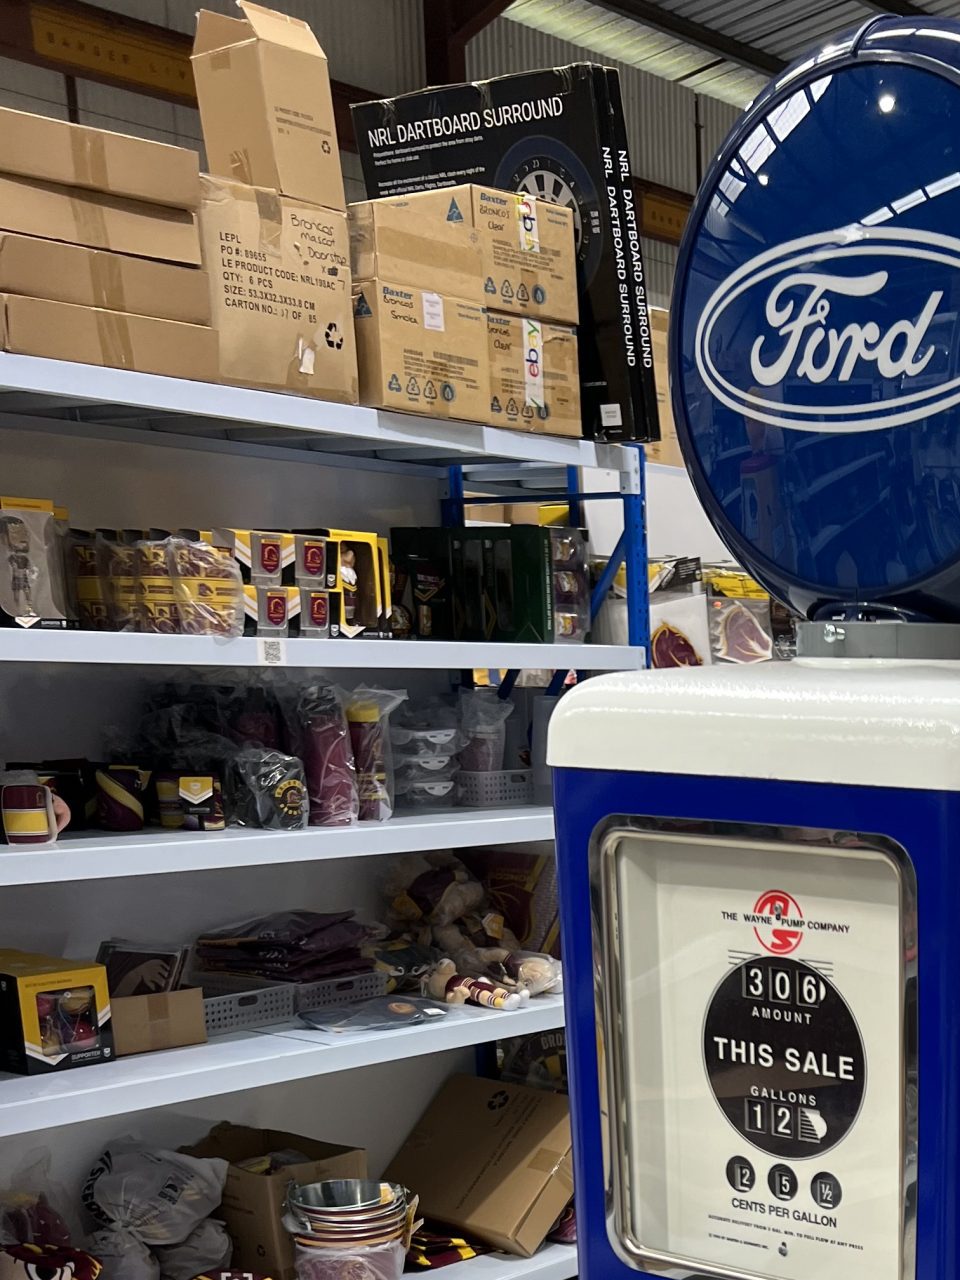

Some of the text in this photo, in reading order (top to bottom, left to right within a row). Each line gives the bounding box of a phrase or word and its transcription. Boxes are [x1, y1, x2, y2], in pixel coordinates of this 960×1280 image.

[368, 97, 563, 148] NRL DARTBOARD SURROUND
[480, 193, 507, 206] Baxter
[219, 232, 241, 244] LEPL
[221, 245, 233, 254] PO
[601, 147, 636, 366] NRL DARTBOARD SURROUND
[618, 150, 652, 368] NRL DARTBOARD SURROUND
[222, 258, 233, 268] LE
[235, 260, 273, 276] PRODUCT
[275, 267, 299, 282] CODE:
[223, 271, 244, 283] QTY:
[258, 278, 273, 289] PCS
[224, 285, 246, 296] SIZE:
[304, 300, 315, 311] CM
[383, 287, 413, 299] Baxter
[225, 298, 259, 312] CARTON
[292, 312, 302, 320] OF
[750, 270, 944, 387] Ford
[526, 320, 540, 377] ebay
[721, 911, 850, 934] THE WAYNE PUMP COMPANY
[752, 1006, 812, 1025] AMOUNT
[714, 1036, 854, 1080] THIS SALE
[751, 1086, 816, 1106] GALLONS
[742, 1169, 750, 1184] 2
[782, 1176, 790, 1193] 5
[732, 1198, 837, 1228] CENTS PER GALLON
